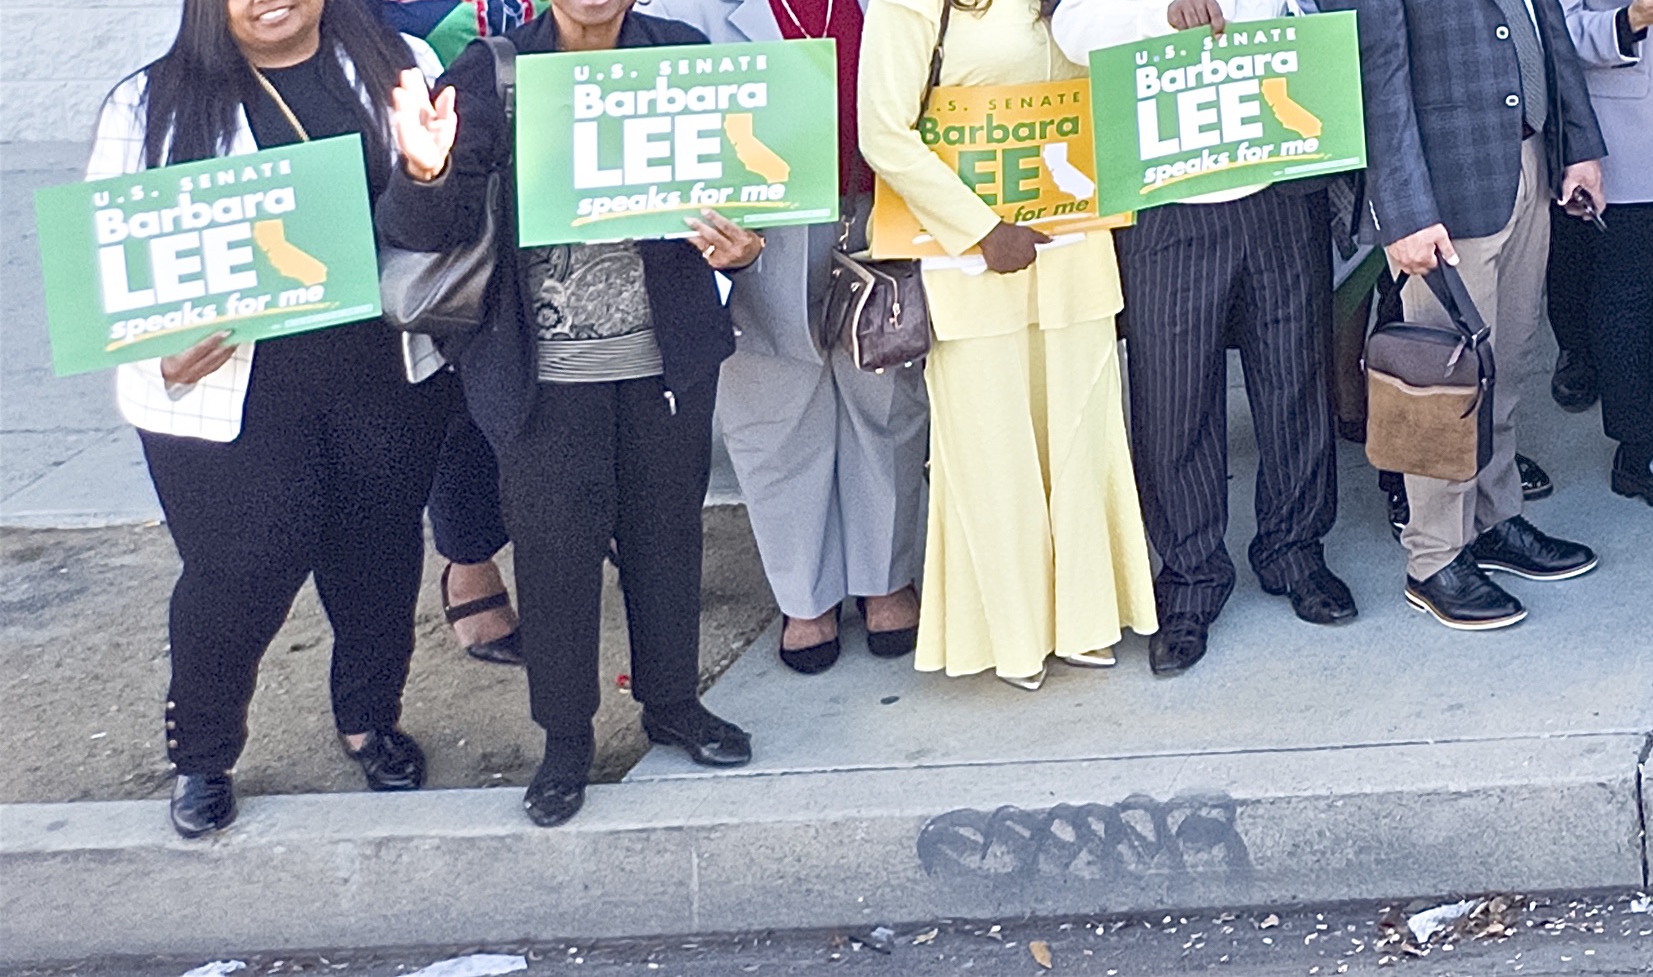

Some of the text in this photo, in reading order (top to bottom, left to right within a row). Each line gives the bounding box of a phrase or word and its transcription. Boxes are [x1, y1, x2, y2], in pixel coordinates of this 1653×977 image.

[574, 55, 767, 81] U.S. SENATE
[1136, 28, 1296, 65] U.S. SENATE
[574, 76, 767, 119] Barbara
[1136, 50, 1298, 99] Barbara
[937, 91, 1080, 111] .S. SENATE
[1137, 79, 1263, 160] LEE
[573, 113, 722, 189] LEE
[919, 114, 1079, 145] Barbara
[93, 160, 291, 207] U.S. SENATE
[958, 145, 1040, 205] EE
[1144, 138, 1319, 186] speaks for me
[95, 187, 296, 244] Barbara
[577, 182, 785, 220] speaks for me
[1014, 200, 1088, 222] for me
[99, 222, 258, 313] LEE
[110, 302, 217, 343] speaks
[225, 292, 271, 317] for
[279, 285, 324, 307] me
